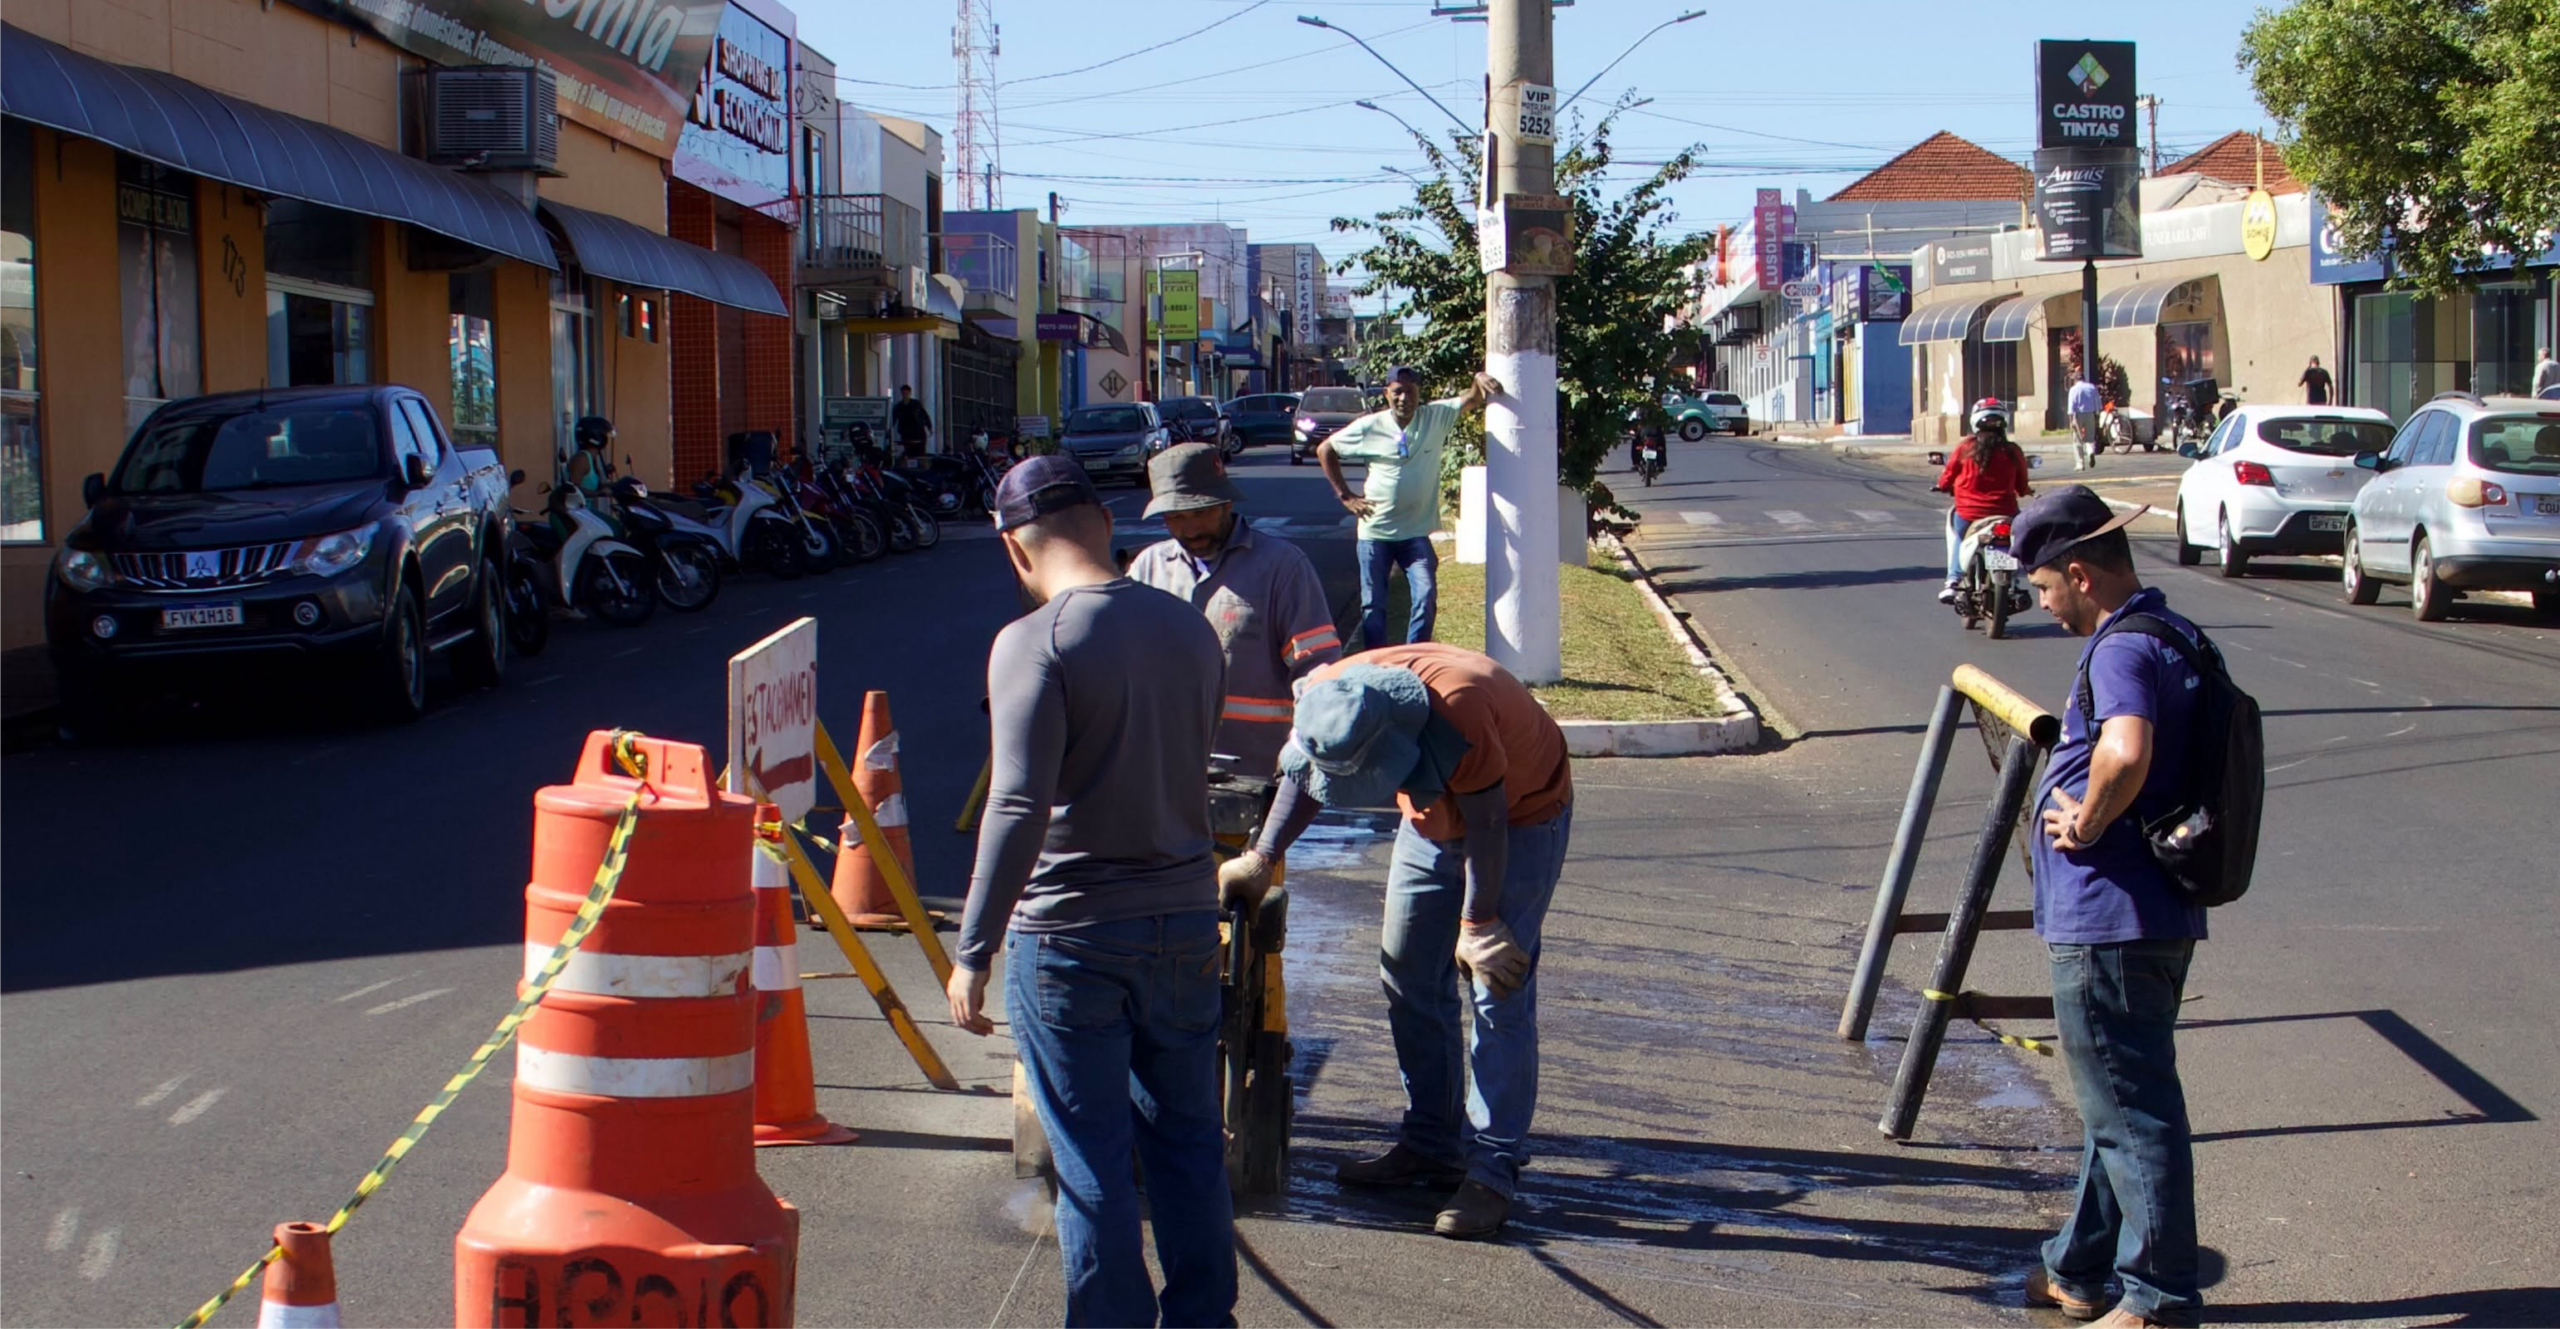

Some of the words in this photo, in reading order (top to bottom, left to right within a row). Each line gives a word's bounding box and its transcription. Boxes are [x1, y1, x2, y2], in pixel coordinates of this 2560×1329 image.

[719, 38, 769, 95] SHOPPING
[769, 66, 782, 99] DA
[1526, 90, 1549, 102] VIP
[721, 90, 784, 153] ECONOMIA
[2053, 103, 2125, 119] CASTRO
[1520, 115, 1550, 136] 5252
[2060, 121, 2119, 137] TINTAS
[1765, 211, 1778, 286] LUSOLAR
[221, 234, 247, 298] 173
[170, 609, 235, 624] FYK1H18
